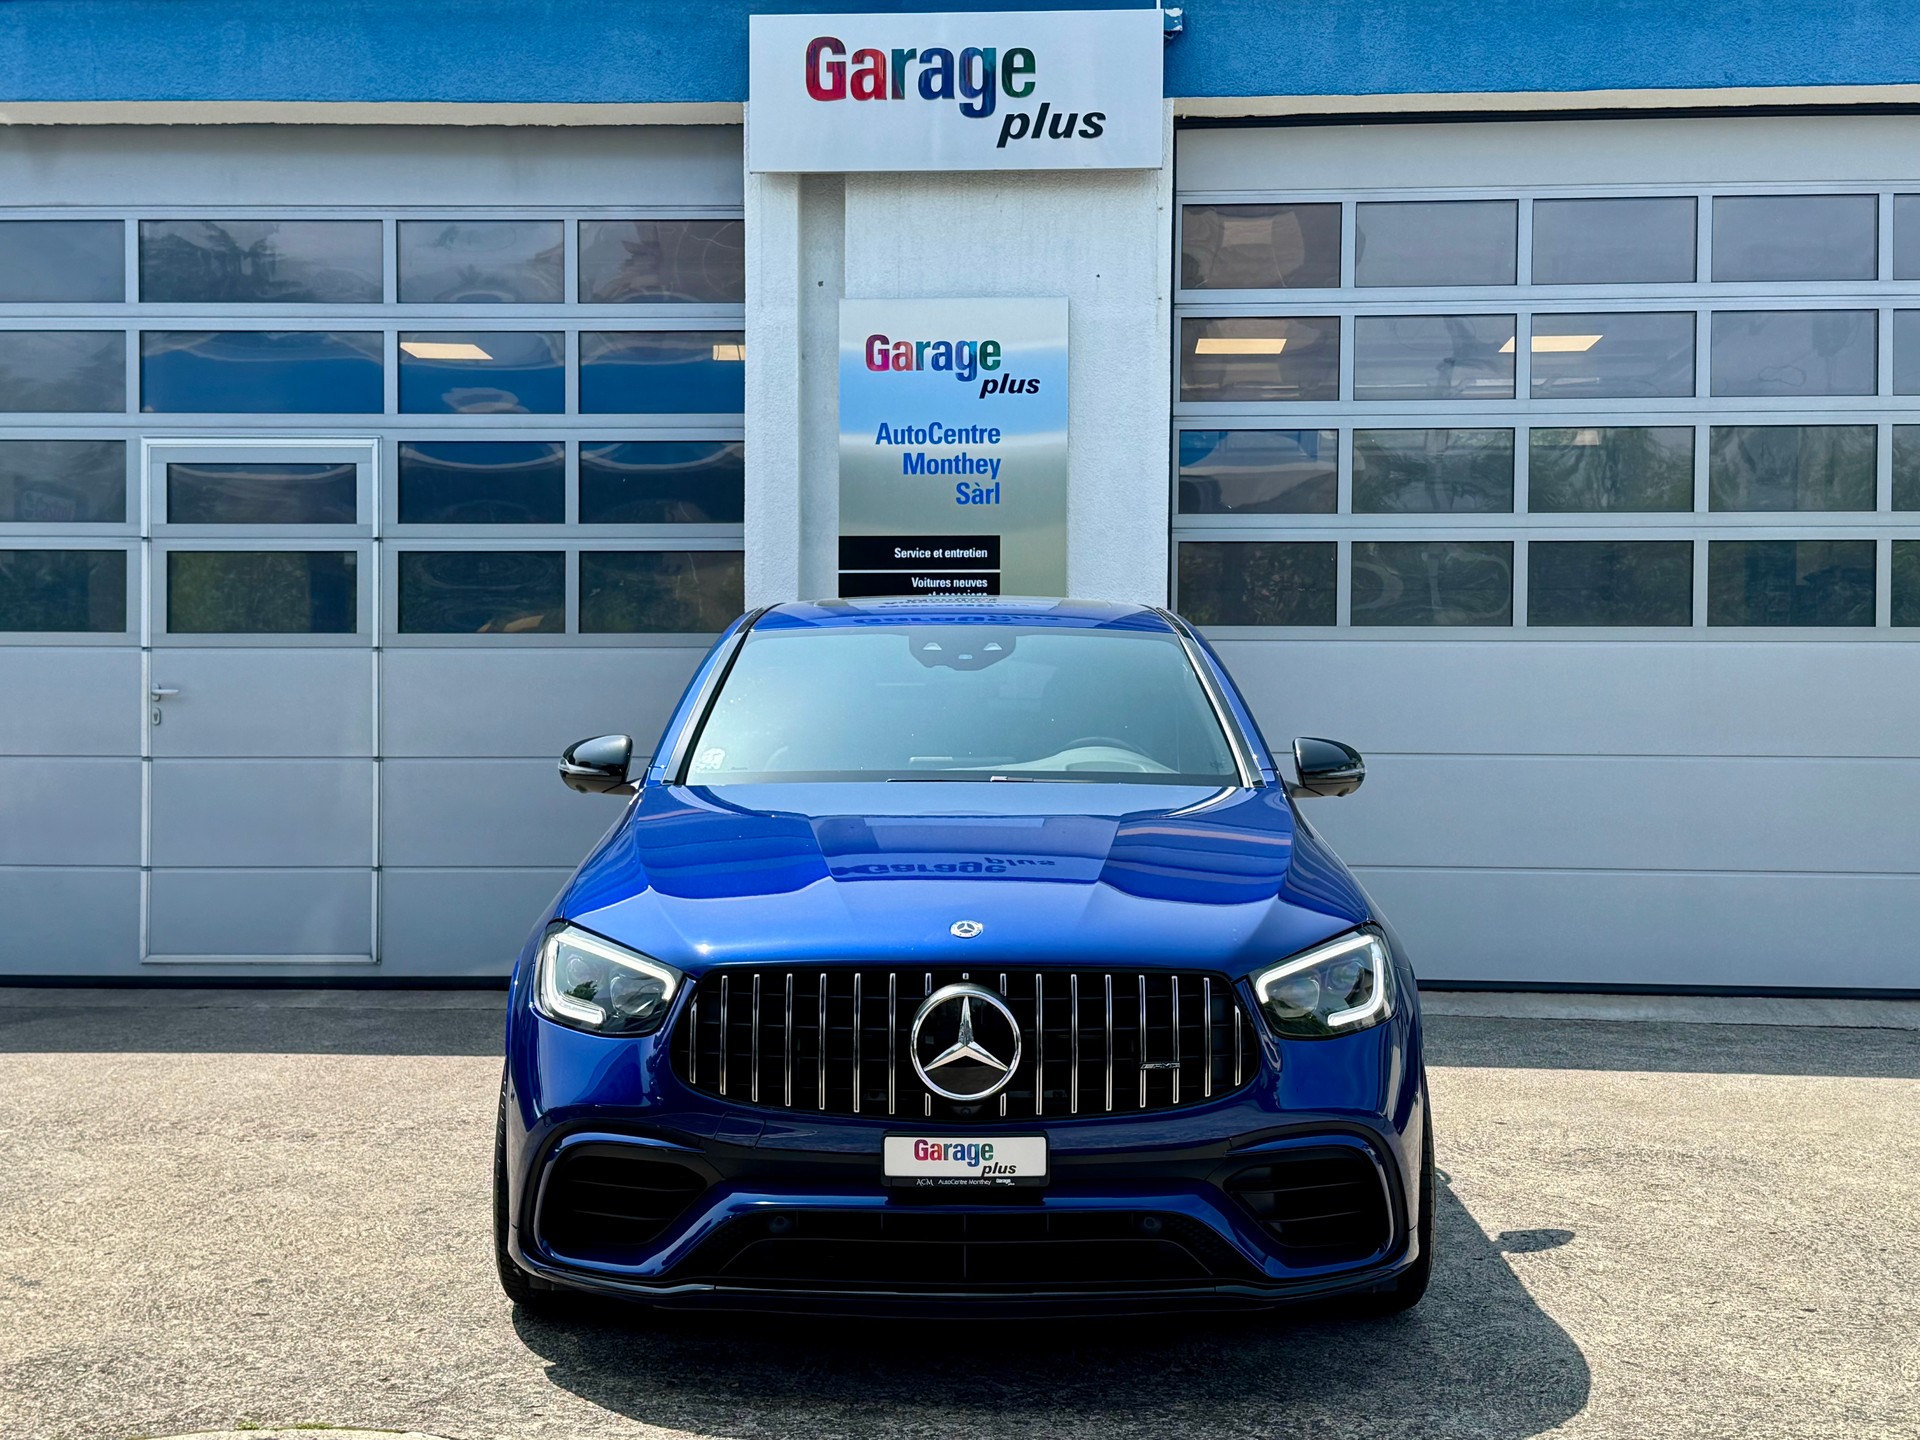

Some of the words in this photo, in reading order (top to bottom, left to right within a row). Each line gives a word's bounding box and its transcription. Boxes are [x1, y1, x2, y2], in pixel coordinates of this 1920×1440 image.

[805, 36, 1036, 119] Garage
[996, 102, 1106, 148] plus
[865, 334, 1001, 382] Garage
[979, 373, 1041, 399] plus
[875, 422, 1001, 445] AutoCentre
[903, 452, 1001, 480] Monthey
[955, 482, 1000, 505] Sàrl
[894, 547, 931, 558] Service
[933, 547, 943, 558] et
[944, 547, 988, 558] entretien
[911, 577, 951, 587] Voitures
[953, 579, 988, 587] neuves
[914, 1139, 994, 1167] Garage
[981, 1162, 1017, 1177] plus
[968, 1178, 991, 1186] Monthey
